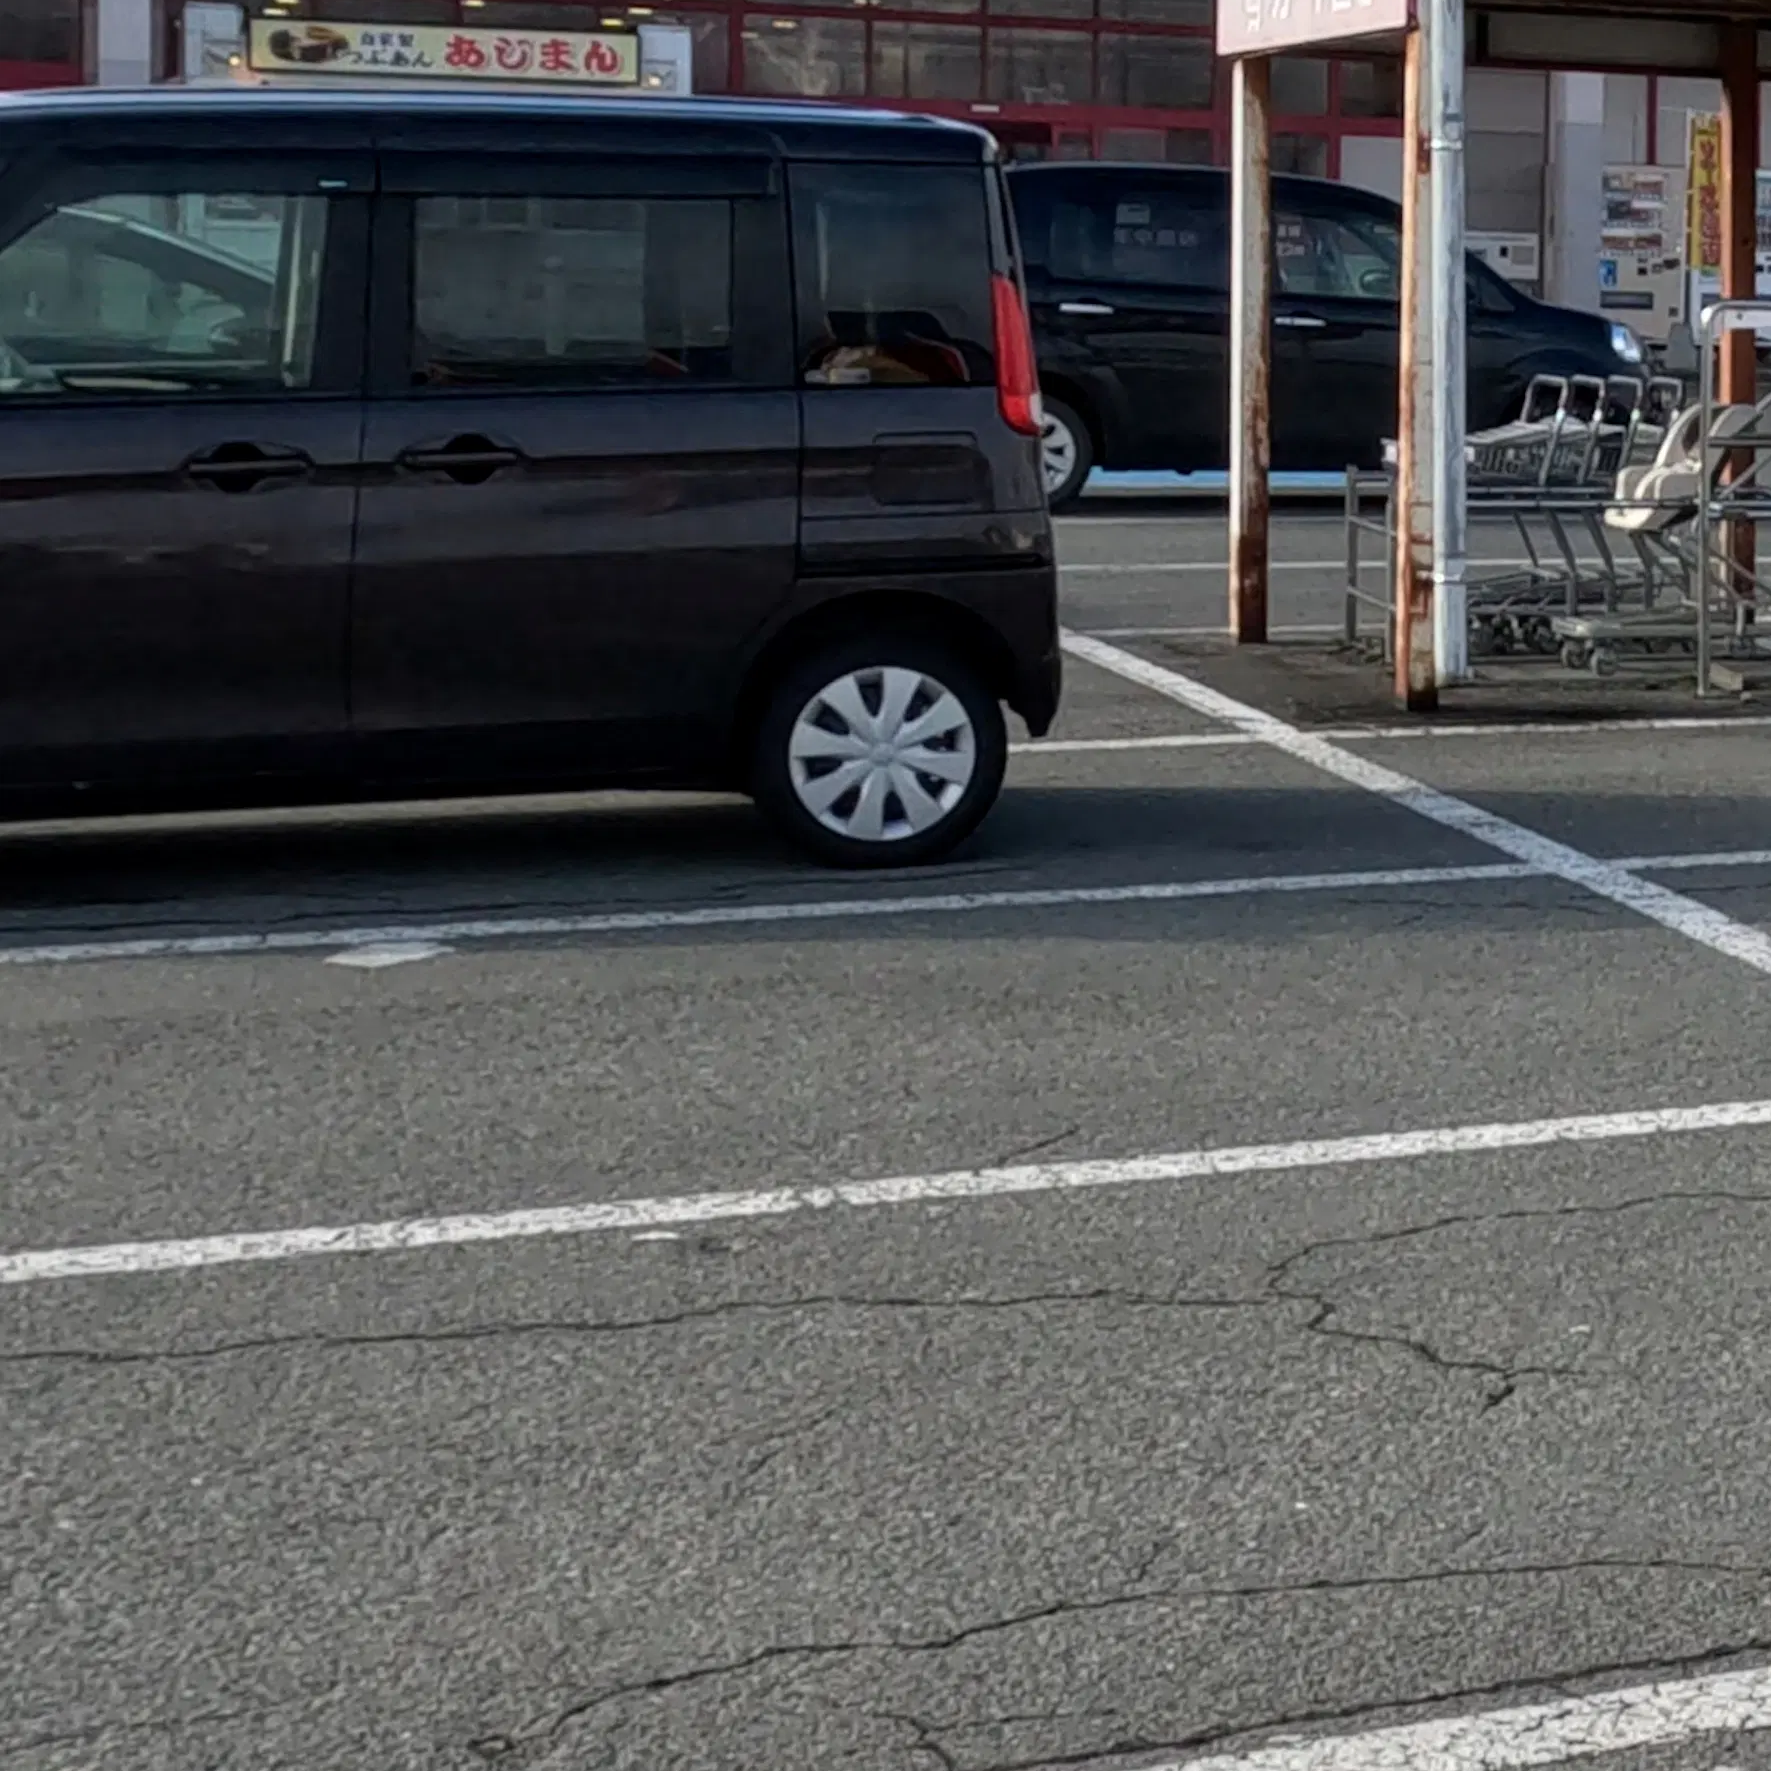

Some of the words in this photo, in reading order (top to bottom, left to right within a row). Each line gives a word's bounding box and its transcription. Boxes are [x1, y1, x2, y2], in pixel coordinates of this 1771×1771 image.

[346, 49, 433, 69] つぶあん
[443, 33, 625, 77] あじまん
